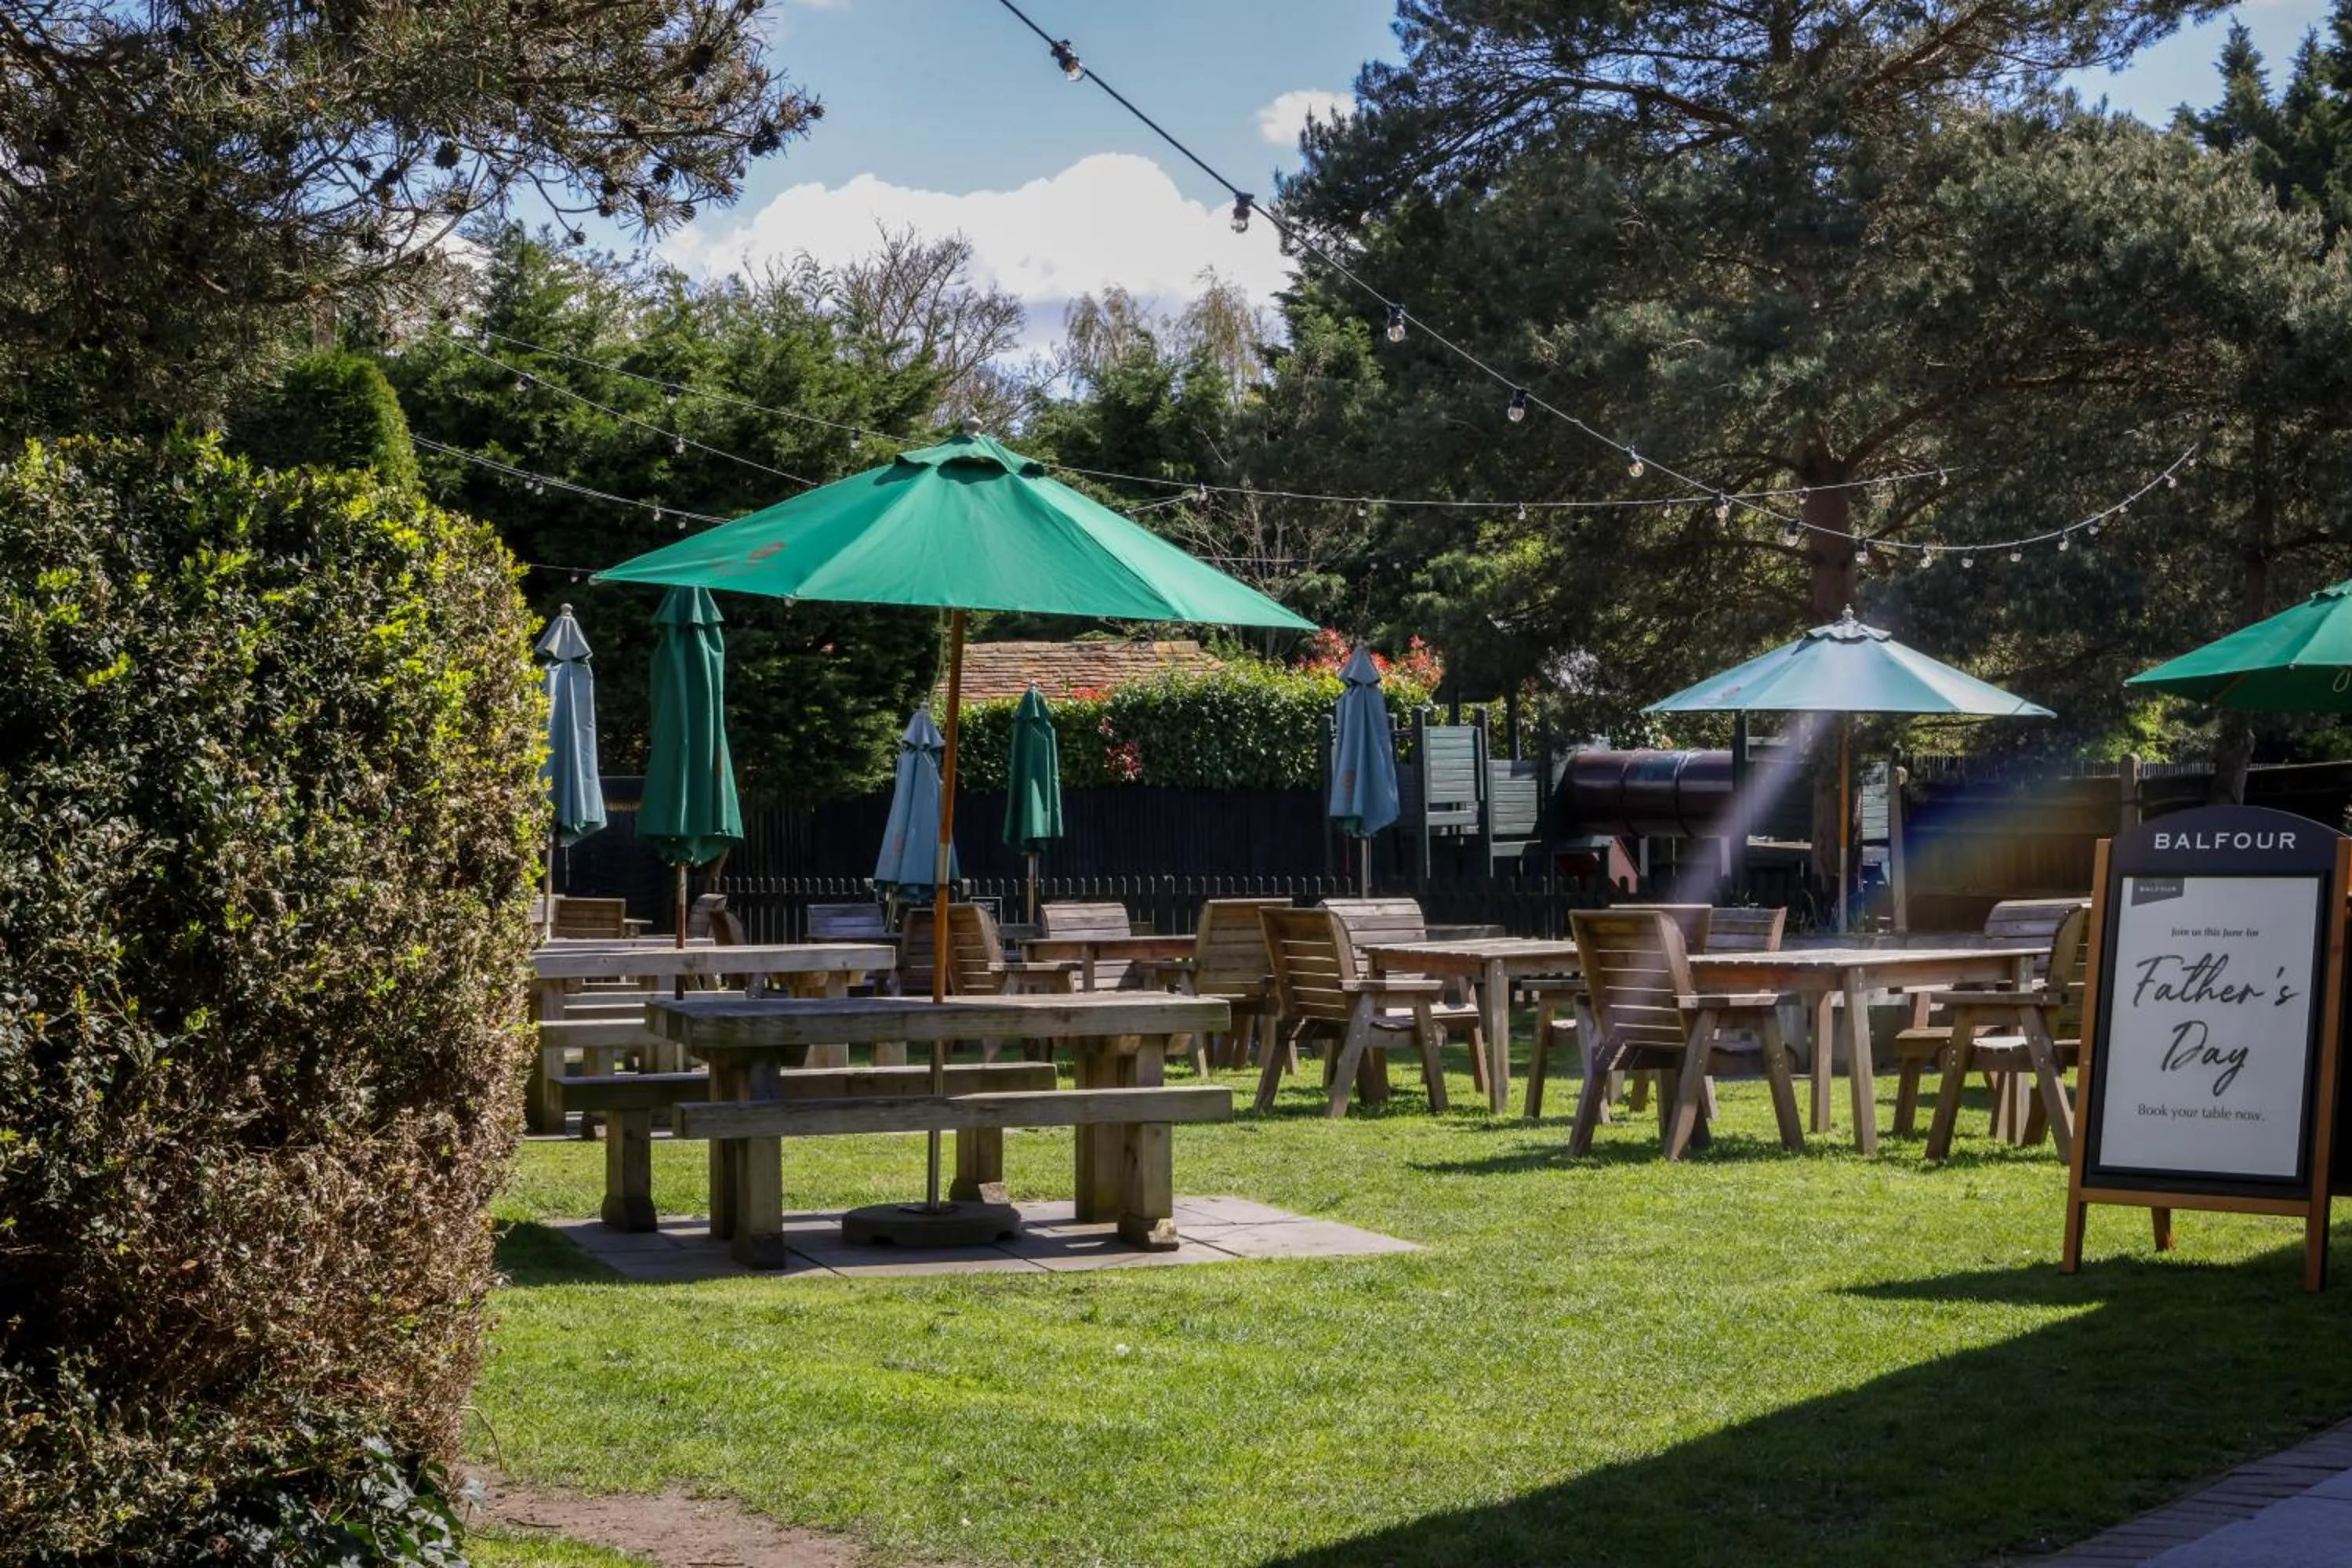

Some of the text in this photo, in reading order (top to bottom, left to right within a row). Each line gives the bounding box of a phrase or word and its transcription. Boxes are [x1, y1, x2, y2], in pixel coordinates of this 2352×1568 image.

[2154, 832, 2296, 849] BALFOUR
[2132, 953, 2301, 1007] Father's
[2161, 1020, 2249, 1097] Day
[2137, 1103, 2265, 1122] Book your table now.
